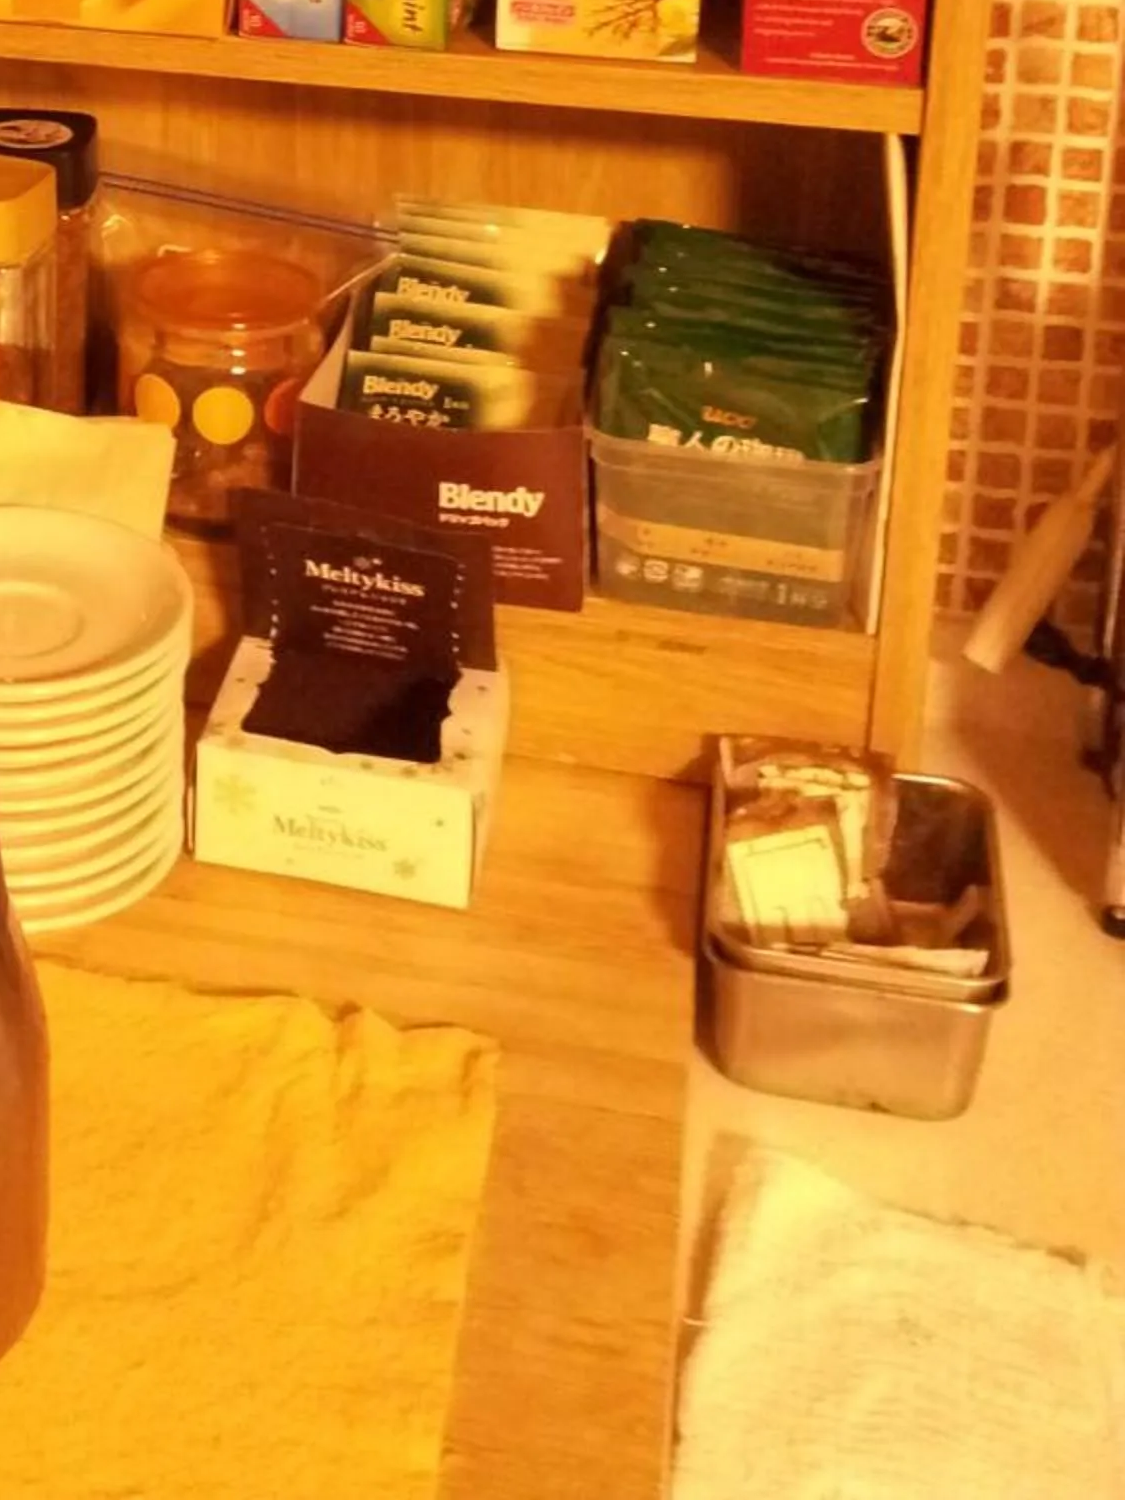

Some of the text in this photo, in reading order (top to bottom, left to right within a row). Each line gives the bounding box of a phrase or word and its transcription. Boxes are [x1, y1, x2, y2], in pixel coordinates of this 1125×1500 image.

[396, 276, 471, 302] Blendy
[388, 319, 463, 347] Blendy
[362, 374, 440, 401] Blendy
[438, 481, 546, 519] Blendy
[303, 557, 426, 598] Meltykiss
[272, 813, 392, 854] Meltykiss
